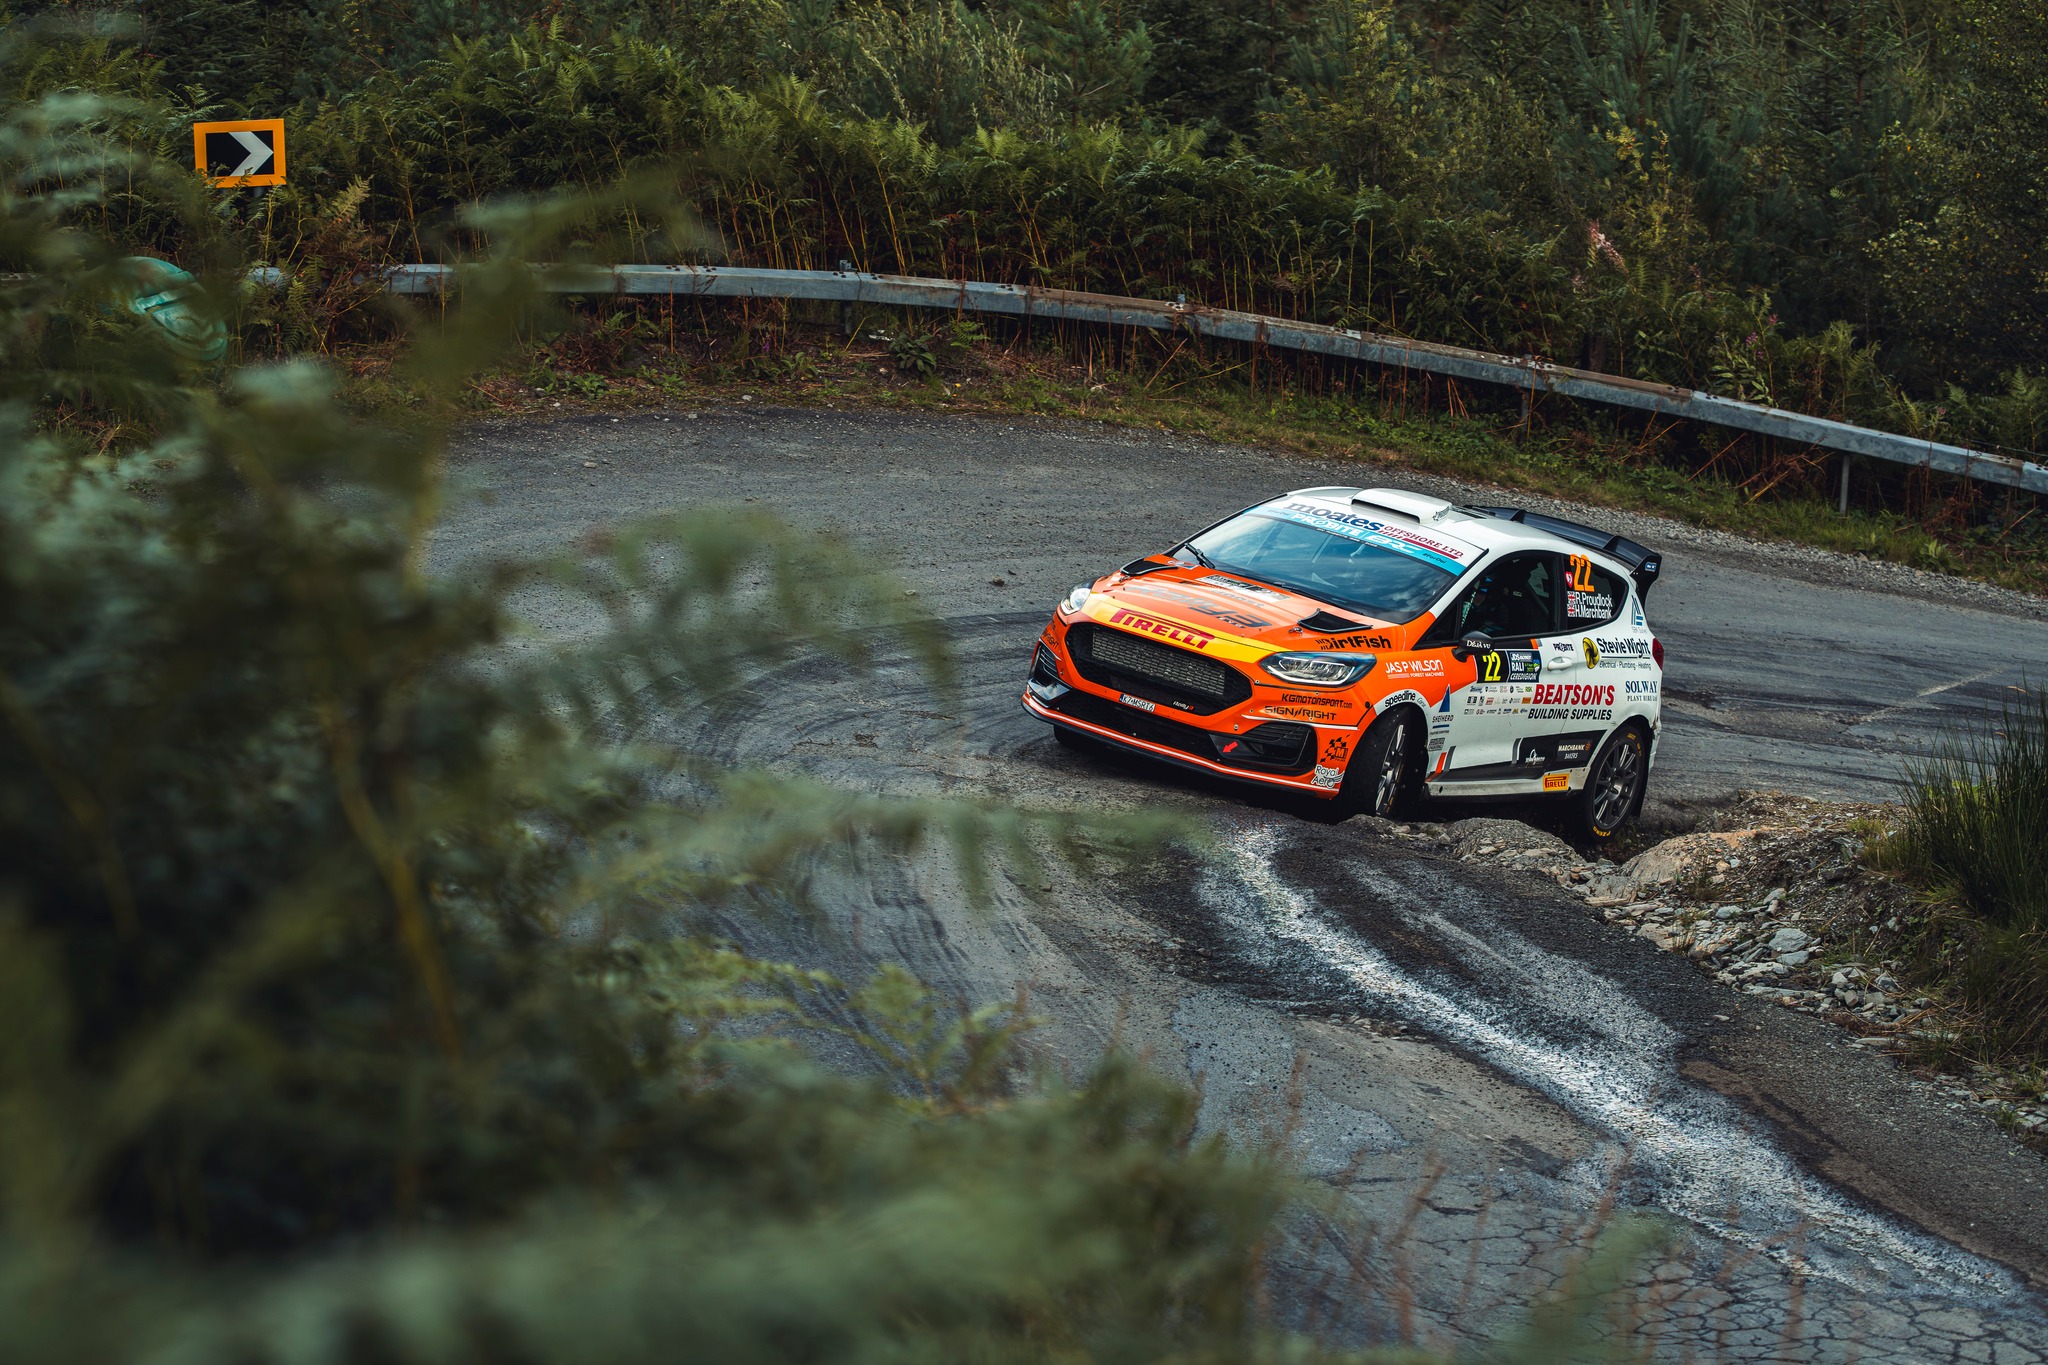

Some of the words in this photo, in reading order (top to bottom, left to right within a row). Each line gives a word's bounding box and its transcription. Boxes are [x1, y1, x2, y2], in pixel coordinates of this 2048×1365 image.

[1283, 502, 1385, 531] moates
[1383, 525, 1442, 548] OFFSHORE
[1442, 544, 1465, 559] LTD
[1569, 553, 1595, 592] 22
[1575, 591, 1613, 608] R.Proudlock
[1575, 603, 1612, 620] H.Marchbank
[1109, 607, 1217, 650] PIRELLI
[1315, 635, 1392, 651] DirtFish
[1596, 637, 1627, 654] Stevie
[1625, 637, 1651, 659] Wight
[1385, 661, 1403, 674] JAS
[1403, 661, 1409, 673] P
[1482, 651, 1502, 682] 22
[1511, 662, 1525, 672] RALI
[1532, 683, 1615, 706] BEATSON'S
[1625, 680, 1658, 694] SOLWAY
[1384, 689, 1417, 708] speedline
[1528, 708, 1570, 720] BUILDING
[1570, 708, 1613, 721] SUPPLIES
[1315, 765, 1339, 778] Royal
[1544, 775, 1567, 789] PIRELLI
